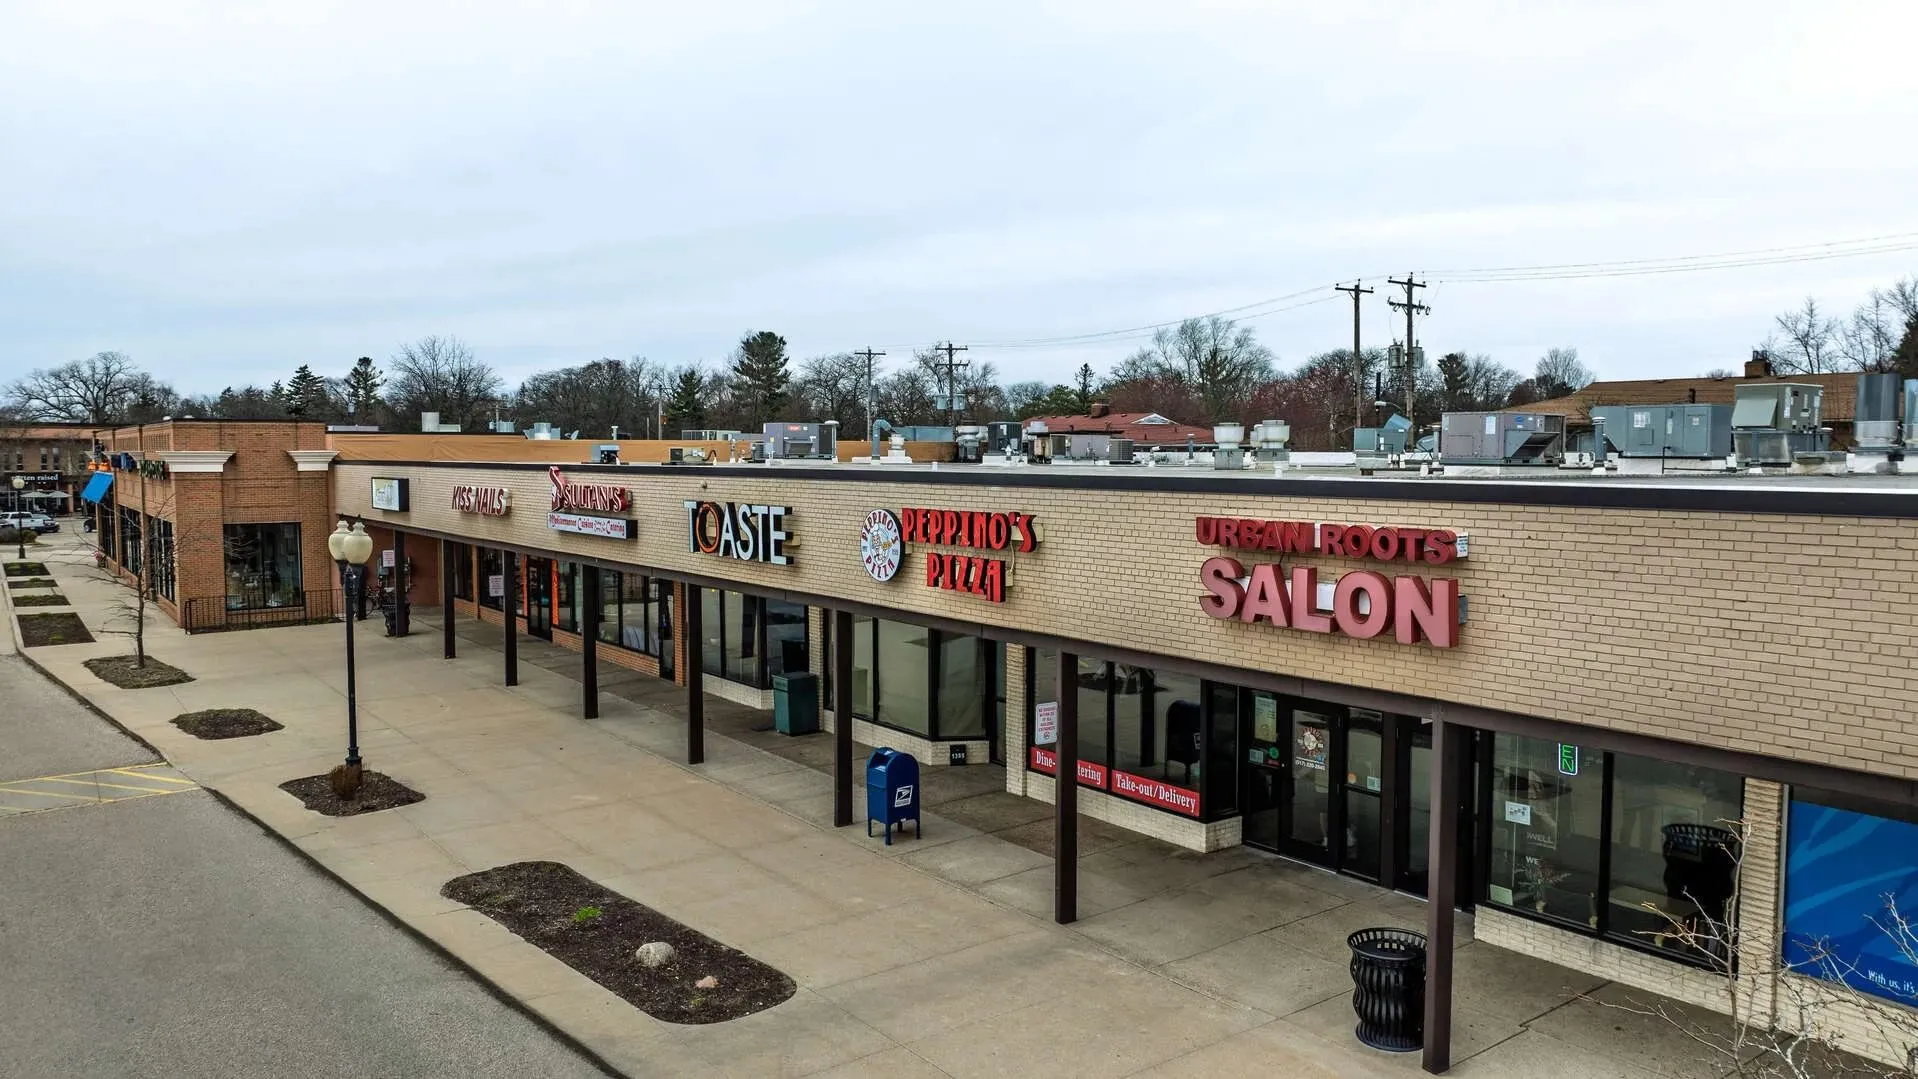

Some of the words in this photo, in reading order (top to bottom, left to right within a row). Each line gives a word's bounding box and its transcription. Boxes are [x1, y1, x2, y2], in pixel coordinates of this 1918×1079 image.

[452, 486, 473, 511] KISS
[475, 487, 504, 516] NAILS
[563, 483, 623, 512] SULTAN'S
[683, 500, 788, 565] TOASTE
[861, 511, 899, 544] PEPPINO'S
[902, 508, 1037, 553] PEPPINO'S
[1196, 517, 1315, 552] URBAN
[1319, 523, 1457, 565] ROOTS
[865, 554, 895, 578] PIZZA
[927, 553, 1006, 603] PIZZA
[1199, 556, 1459, 649] SALON
[1036, 751, 1057, 768] Dine-
[1077, 766, 1102, 784] tering
[1562, 744, 1575, 772] EN
[1115, 774, 1196, 813] Take-out/Delivery
[1868, 969, 1886, 985] With
[1889, 979, 1900, 991] us,
[1903, 980, 1915, 993] it's
